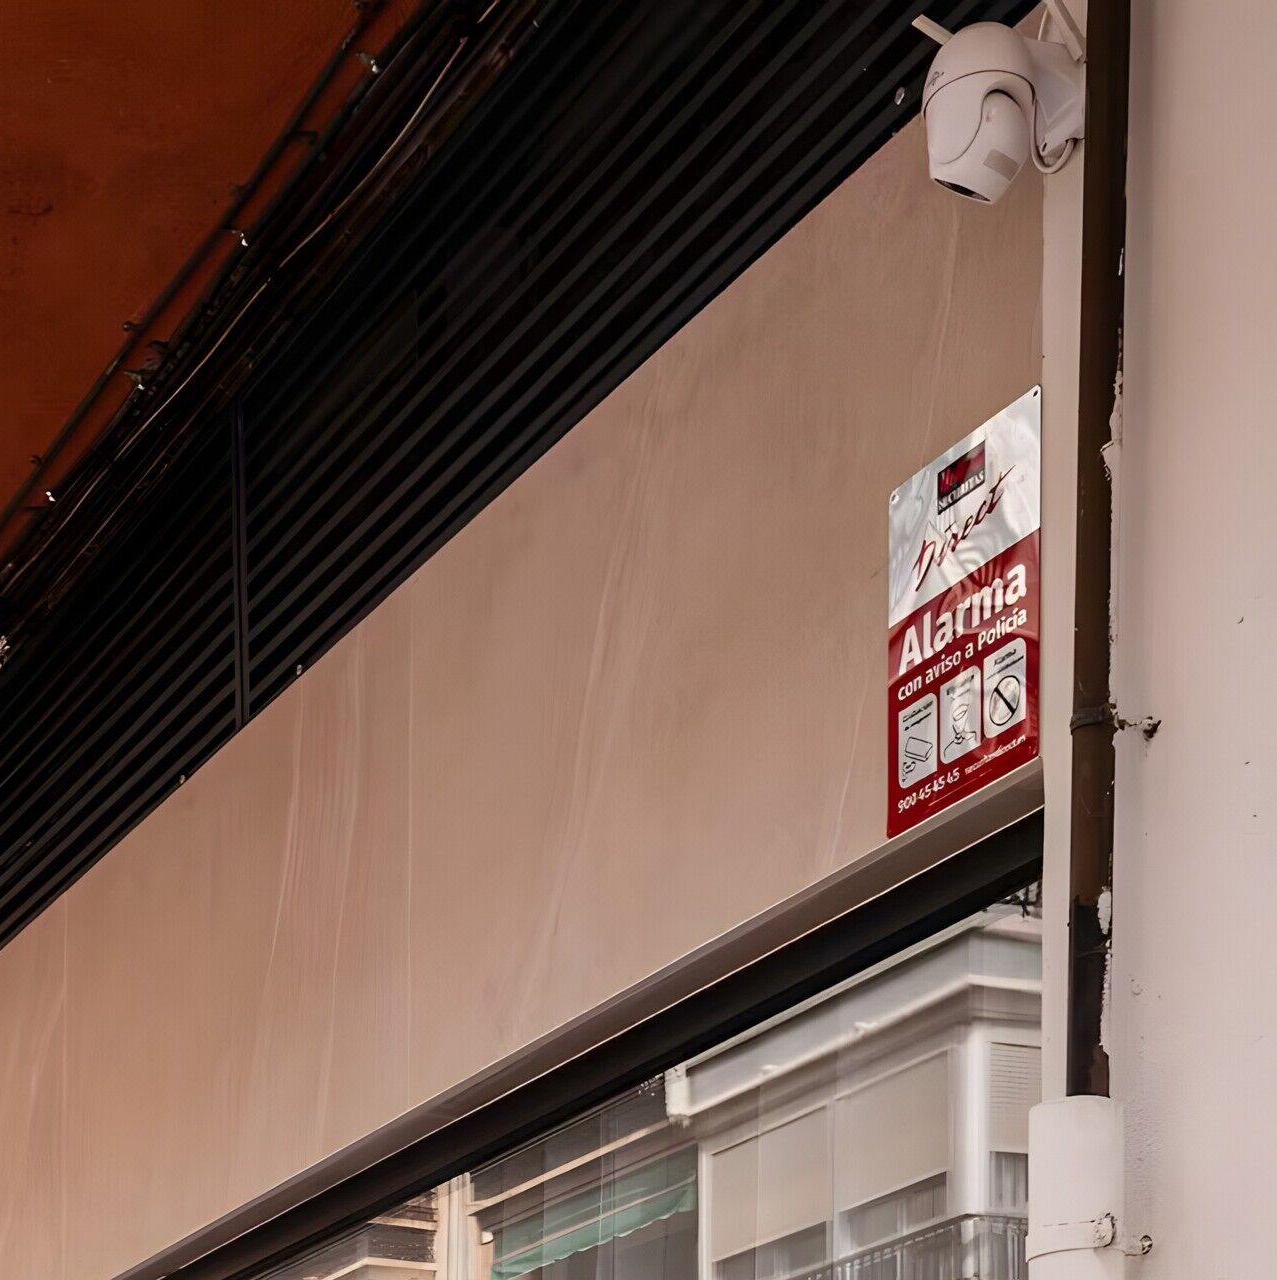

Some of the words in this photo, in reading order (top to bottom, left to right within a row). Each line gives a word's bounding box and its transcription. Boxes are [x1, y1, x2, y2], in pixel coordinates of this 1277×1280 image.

[898, 563, 1027, 676] Alarma
[898, 675, 922, 700] con
[925, 651, 961, 684] aviso
[965, 642, 974, 658] a
[978, 607, 1027, 651] Policía
